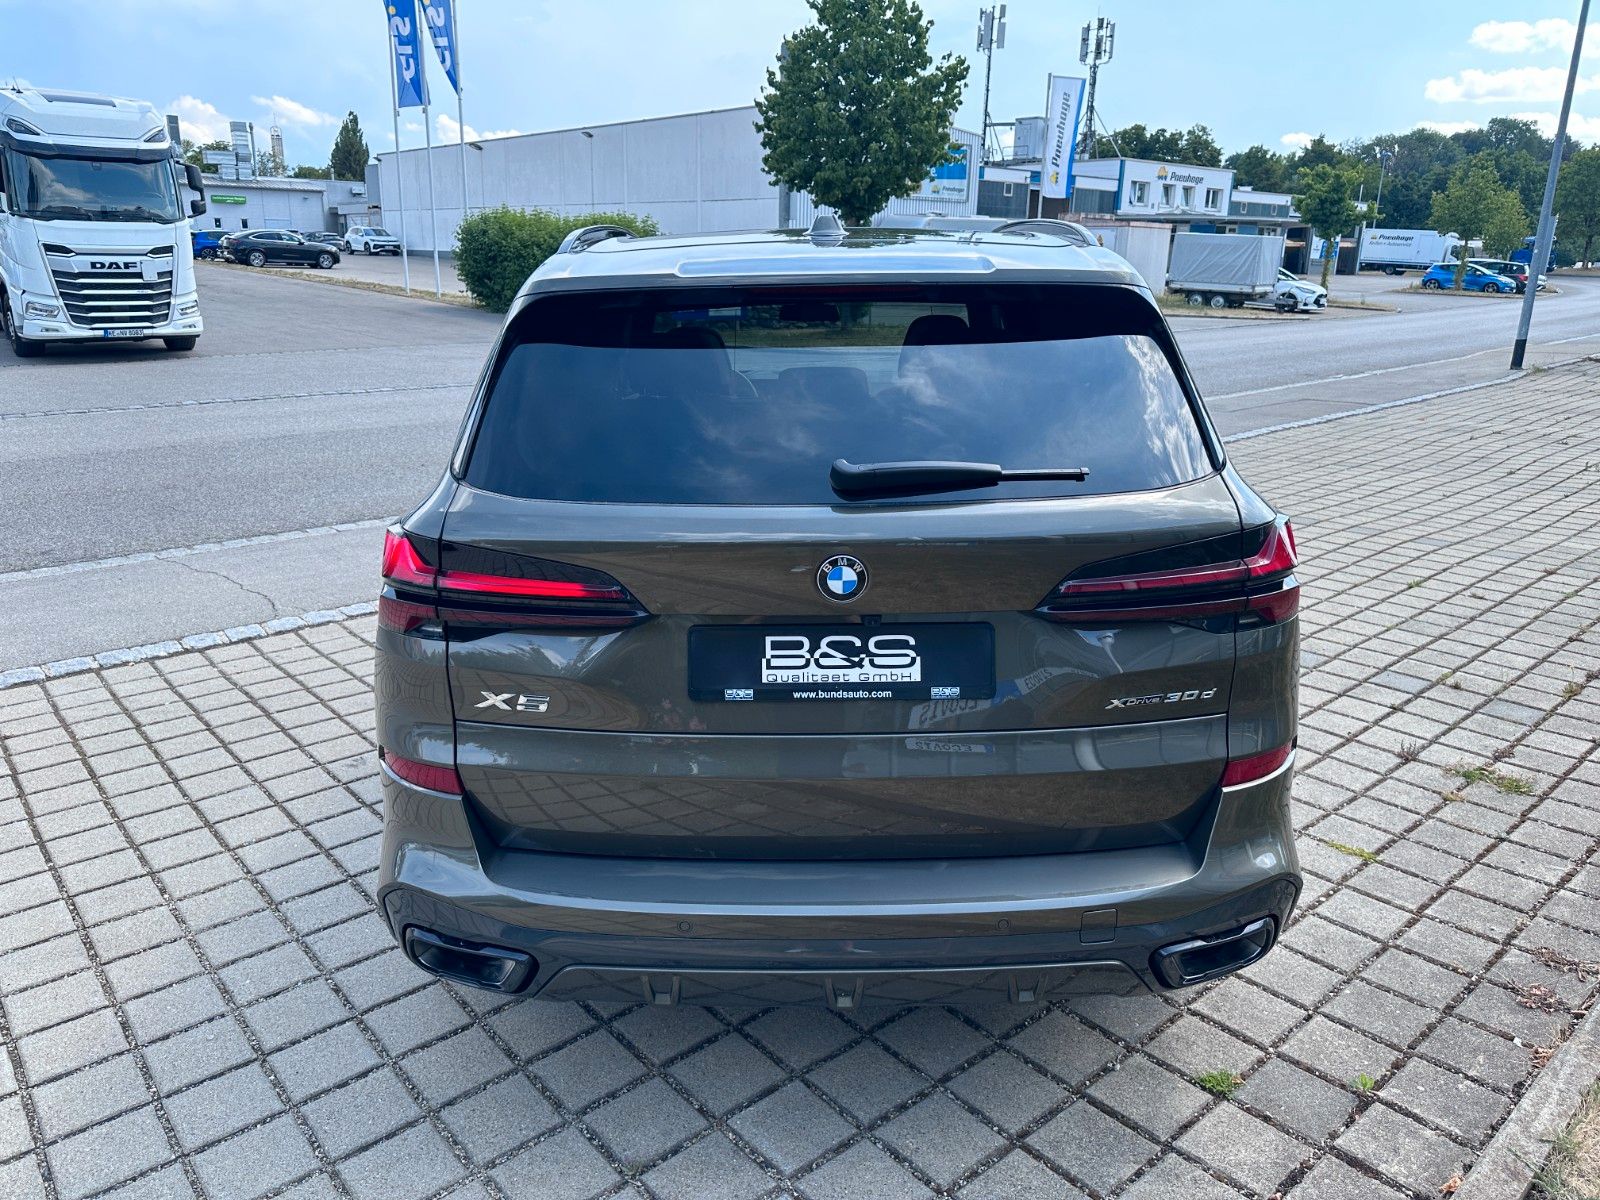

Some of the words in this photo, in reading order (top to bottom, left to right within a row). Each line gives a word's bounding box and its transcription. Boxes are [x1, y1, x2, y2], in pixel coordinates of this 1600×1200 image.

[1051, 91, 1071, 168] Pneuhage
[1170, 171, 1204, 185] Pneuhage
[1378, 234, 1414, 242] Pneuhage
[90, 262, 138, 270] DAF
[823, 557, 863, 573] BMW
[764, 635, 917, 670] B&S
[766, 672, 850, 683] Qualitaet
[792, 689, 892, 699] www.bundsauto.com
[473, 691, 551, 713] X5
